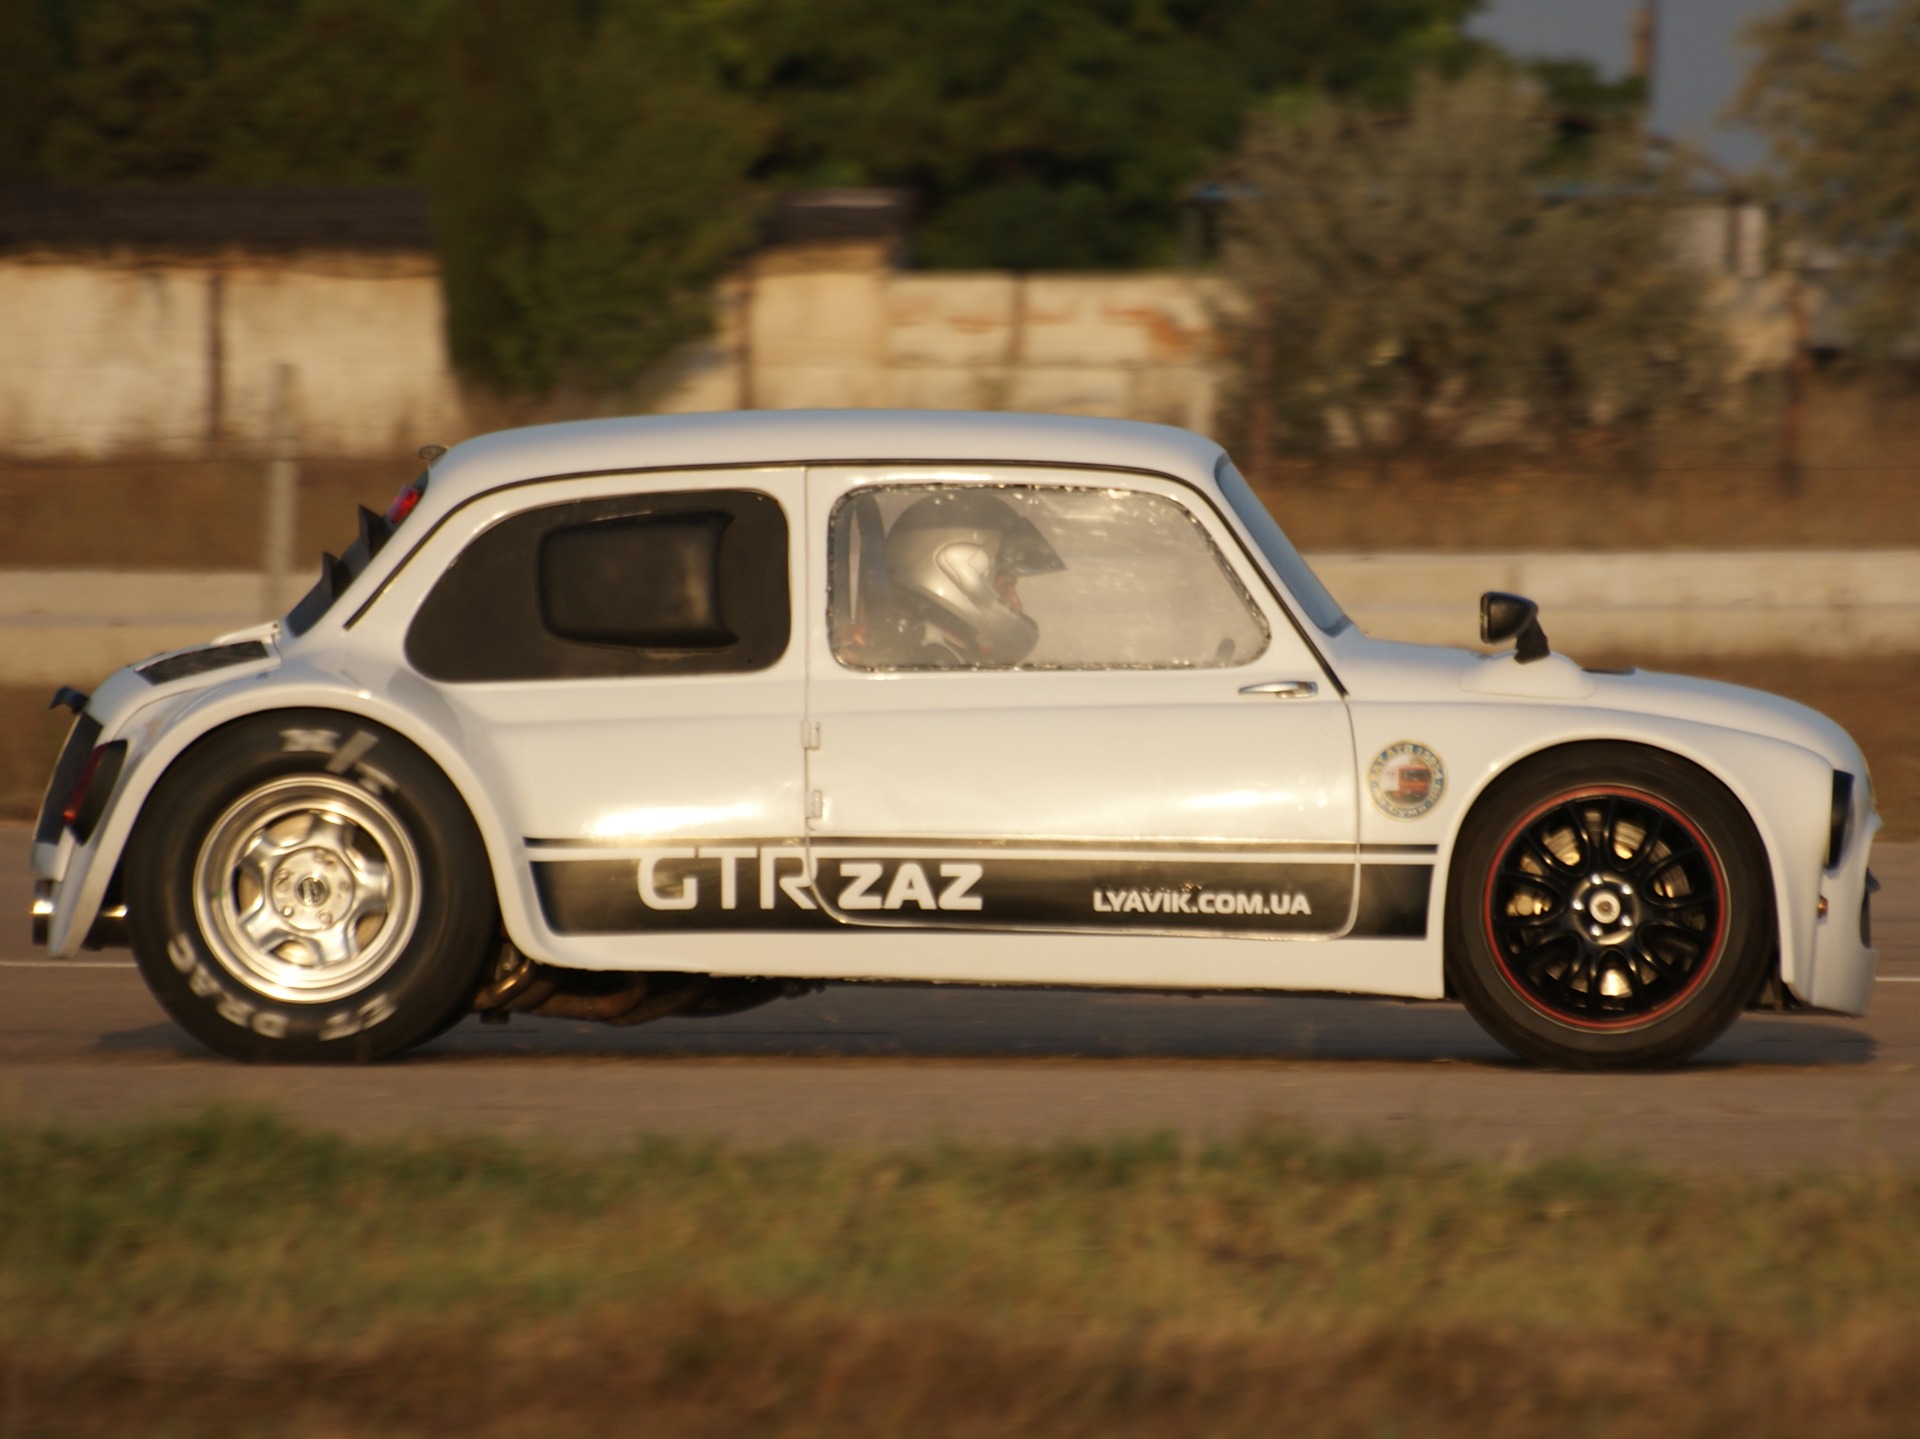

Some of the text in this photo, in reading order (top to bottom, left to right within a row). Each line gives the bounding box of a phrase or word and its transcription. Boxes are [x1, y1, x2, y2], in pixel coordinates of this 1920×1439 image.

[637, 847, 984, 911] GTR ZAZ
[1093, 889, 1312, 916] LYAVIK.COM.UA
[168, 932, 290, 1040] DRAG
